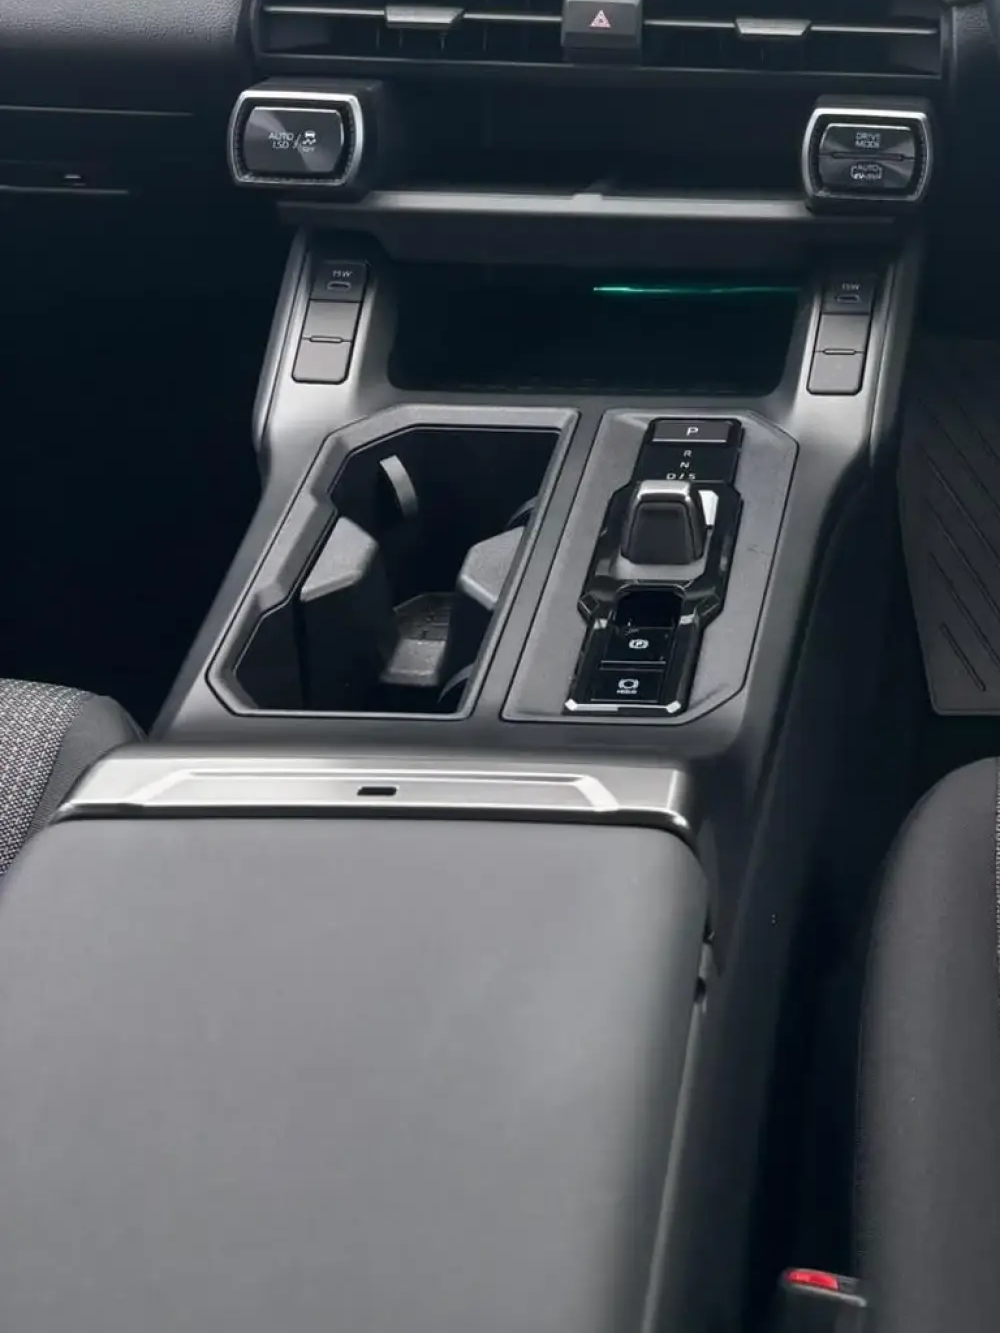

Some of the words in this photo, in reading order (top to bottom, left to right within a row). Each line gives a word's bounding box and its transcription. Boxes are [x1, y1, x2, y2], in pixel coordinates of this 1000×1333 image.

[268, 131, 294, 141] AUTO
[855, 140, 880, 149] MODE
[686, 426, 699, 436] P
[683, 449, 692, 457] R
